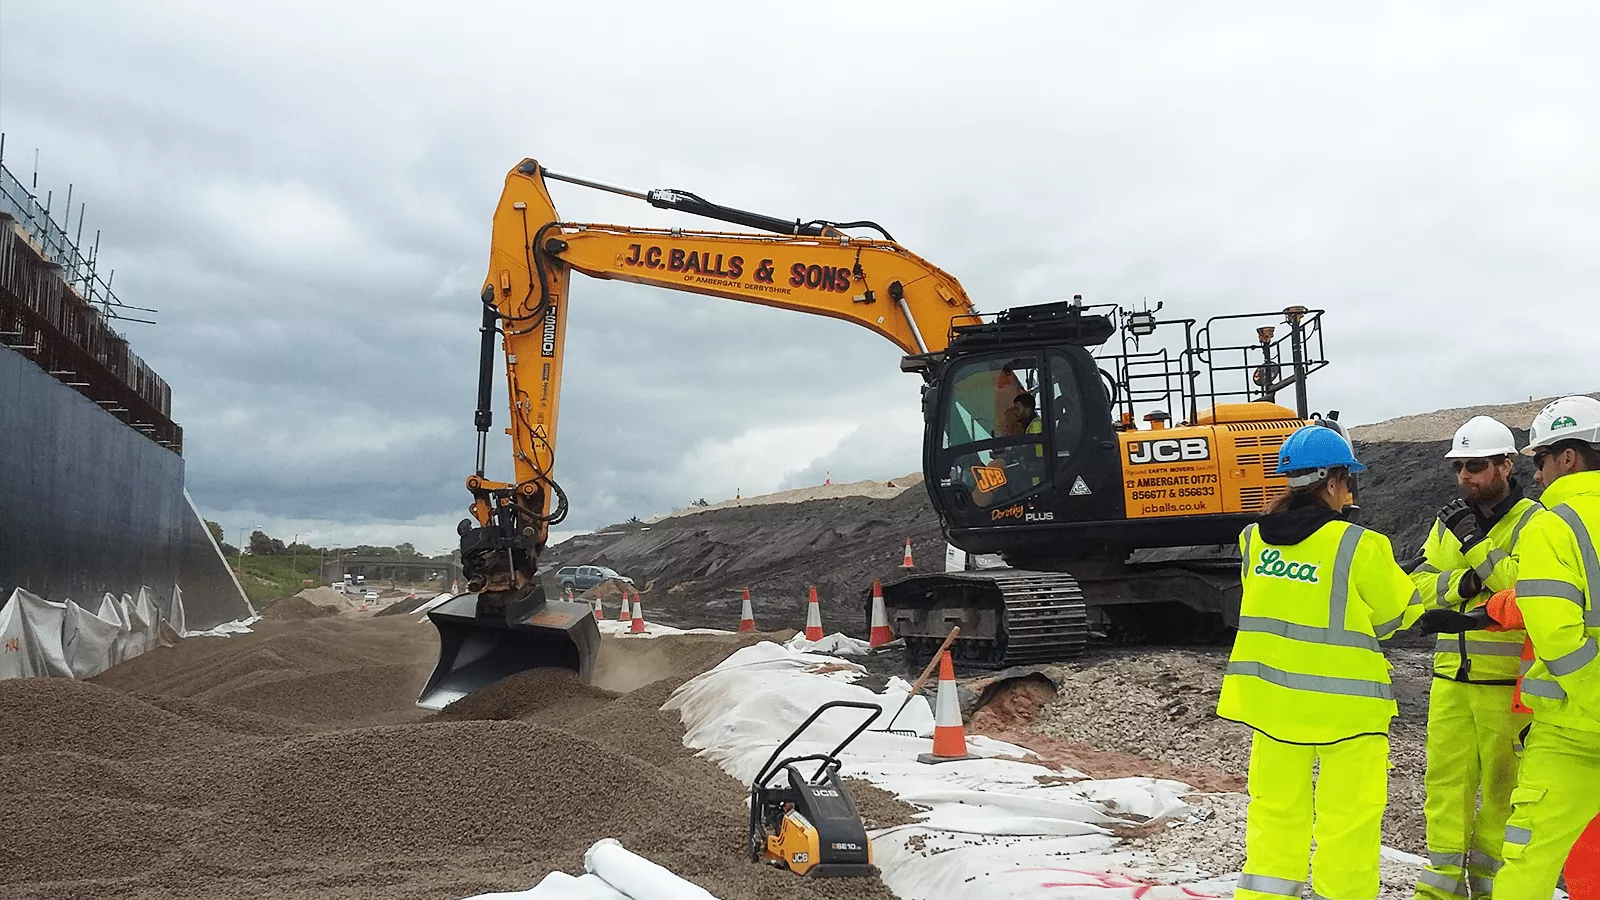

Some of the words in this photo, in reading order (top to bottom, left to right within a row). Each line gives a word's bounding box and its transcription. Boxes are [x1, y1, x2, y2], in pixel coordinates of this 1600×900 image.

[753, 259, 775, 285] &
[789, 262, 852, 293] SONS
[684, 275, 695, 283] OF
[696, 276, 742, 289] AMBERGATE
[744, 283, 792, 295] DERBYSHIRE
[1129, 438, 1209, 464] JCB
[977, 469, 1004, 489] JCB
[1137, 476, 1190, 488] AMBERGATE
[1190, 474, 1218, 485] 01773
[1131, 489, 1167, 500] 856677
[1169, 488, 1177, 498] &
[1178, 486, 1215, 497] 856633
[991, 504, 1024, 521] Dorothy
[1141, 501, 1206, 515] jcballs.co.uk
[1025, 512, 1054, 522] PLUS
[1255, 548, 1319, 583] Leca
[811, 789, 839, 797] JCB
[792, 853, 808, 863] JCB
